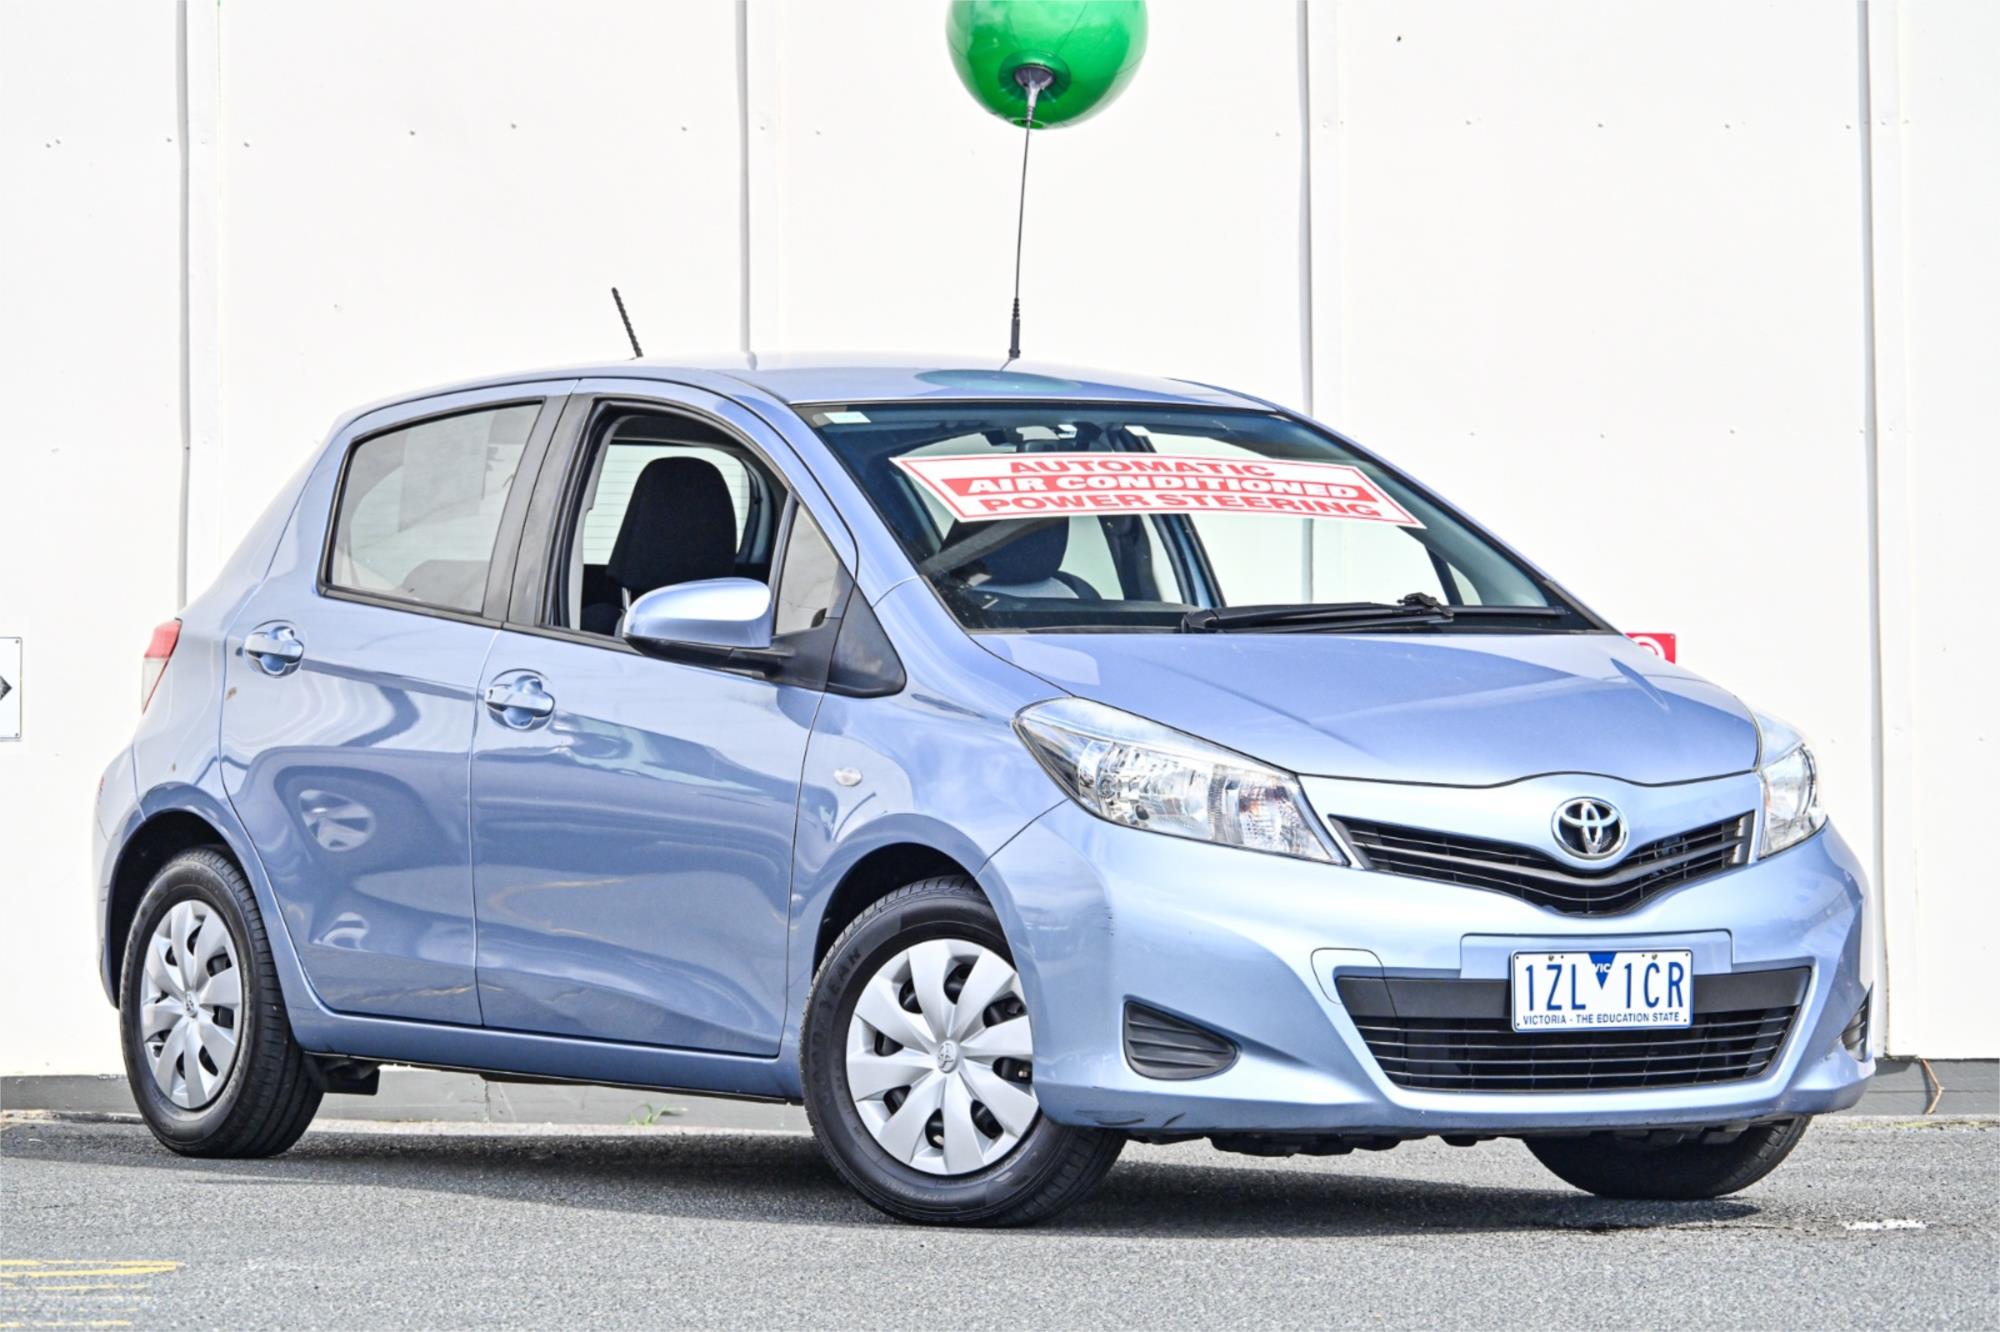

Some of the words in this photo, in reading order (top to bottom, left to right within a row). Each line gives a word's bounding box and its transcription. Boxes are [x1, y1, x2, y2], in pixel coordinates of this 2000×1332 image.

[1010, 460, 1275, 477] AUTOMATIC
[967, 476, 1049, 494] AIR
[1056, 475, 1360, 499] CONDITIONED
[979, 494, 1151, 512] POWER
[1154, 494, 1382, 517] STEERING
[1525, 963, 1587, 1012] 1ZL
[1623, 961, 1685, 1010] 1CR
[1523, 1015, 1566, 1025] VICTORIA
[1576, 1014, 1594, 1024] THE
[1597, 1013, 1649, 1023] EDUCATION
[1652, 1012, 1680, 1022] STATE
